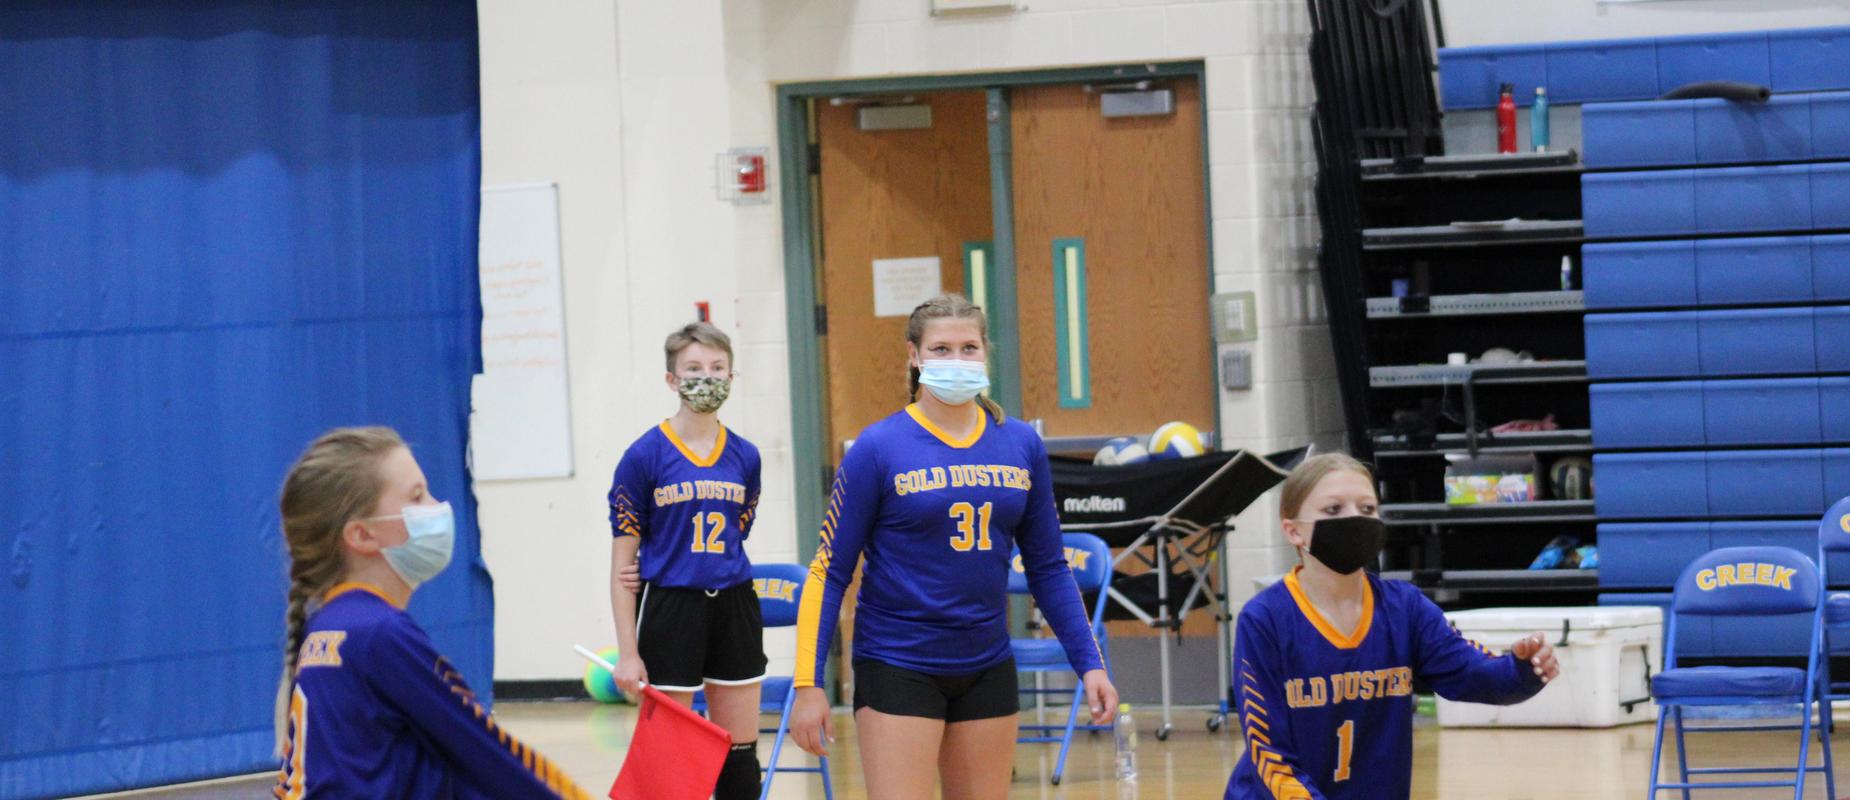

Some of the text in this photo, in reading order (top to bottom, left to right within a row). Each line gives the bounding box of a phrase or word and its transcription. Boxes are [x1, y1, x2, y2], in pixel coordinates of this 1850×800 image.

[654, 481, 694, 507] GOLD
[894, 464, 1032, 496] GOLD DUSTERS
[1064, 495, 1125, 512] molten
[691, 511, 726, 553] 12
[949, 501, 993, 551] 31
[1696, 563, 1797, 591] CREEK
[1334, 720, 1354, 782] 1
